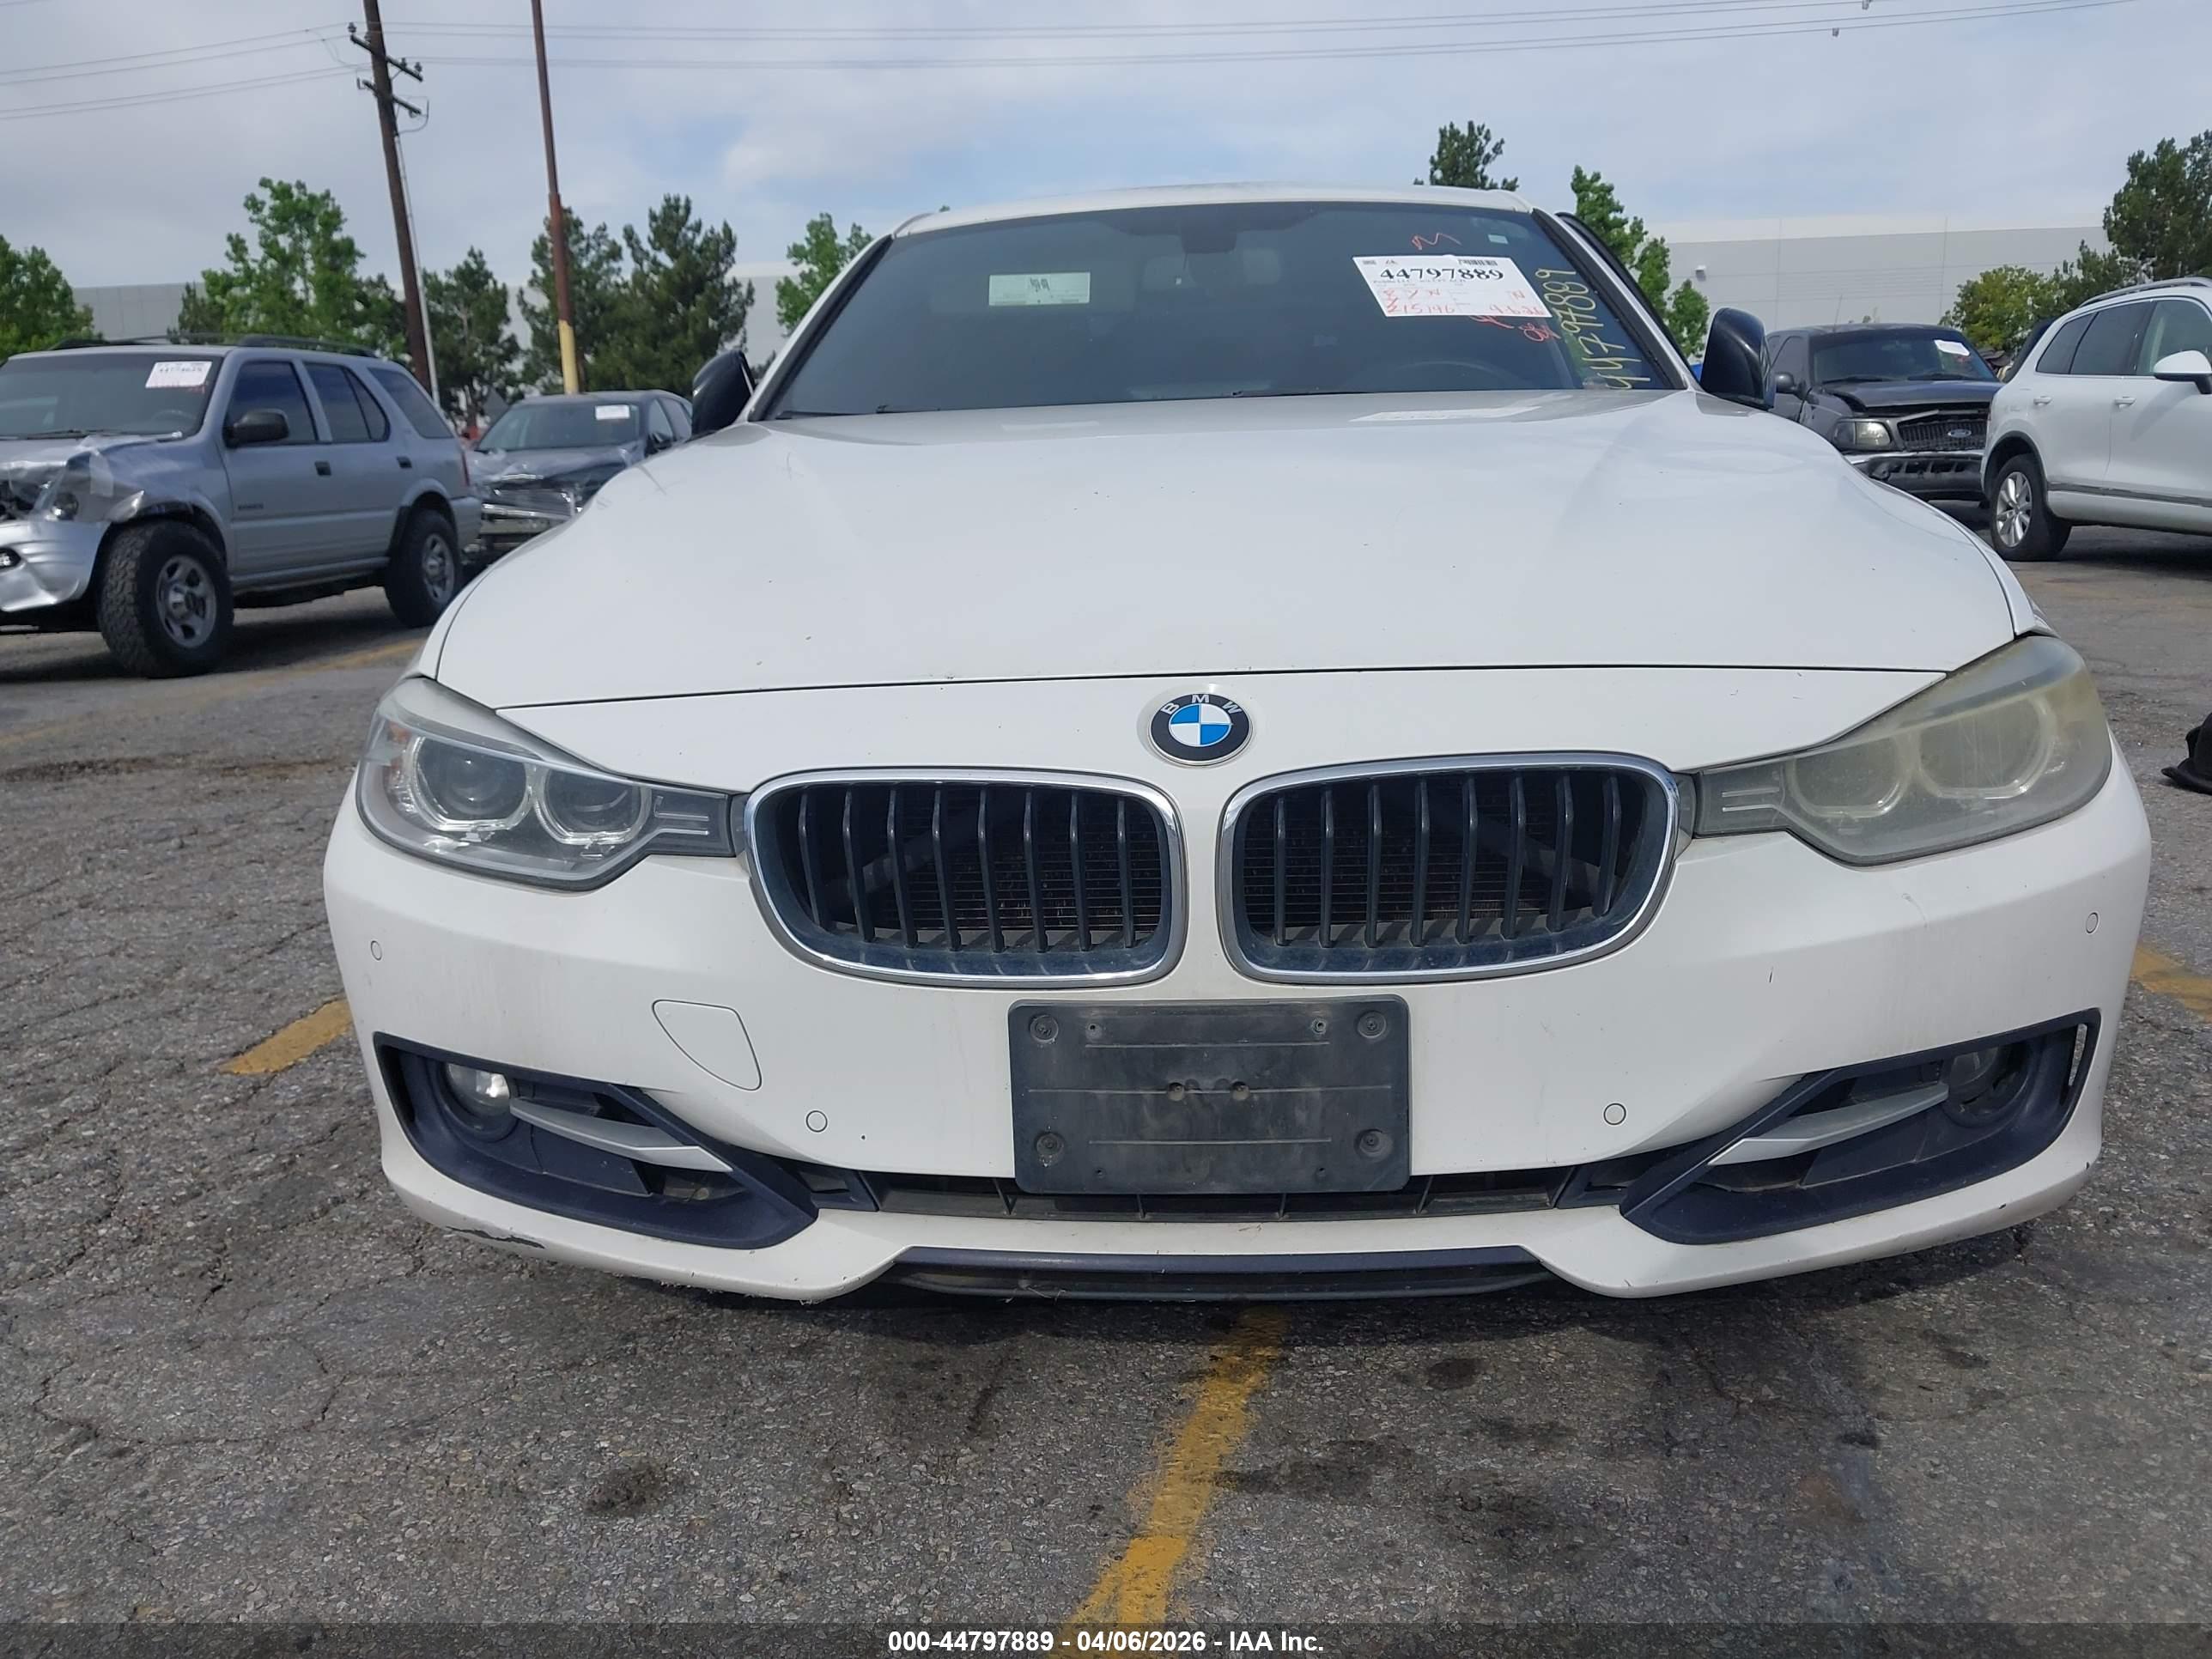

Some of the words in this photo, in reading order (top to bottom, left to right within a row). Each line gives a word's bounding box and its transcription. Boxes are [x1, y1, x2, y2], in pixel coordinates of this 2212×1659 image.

[1380, 267, 1504, 281] 44797889
[1534, 267, 1650, 390] 44797889
[1161, 694, 1243, 716] BMW
